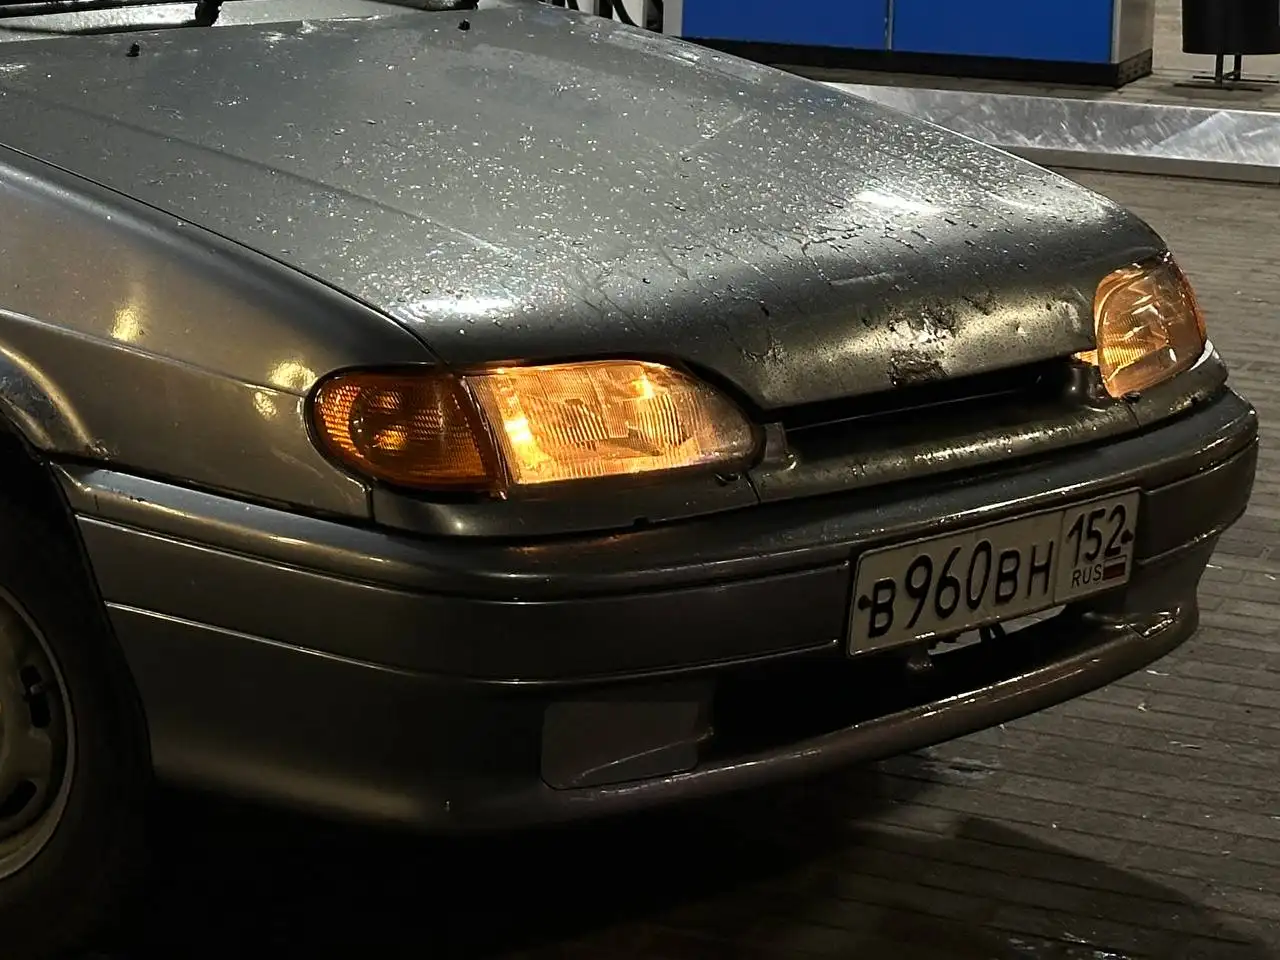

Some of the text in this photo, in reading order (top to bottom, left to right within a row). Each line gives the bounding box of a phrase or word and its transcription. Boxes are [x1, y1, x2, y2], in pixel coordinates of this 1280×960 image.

[868, 504, 1128, 638] В960ВН 152
[1071, 563, 1103, 588] RUS
